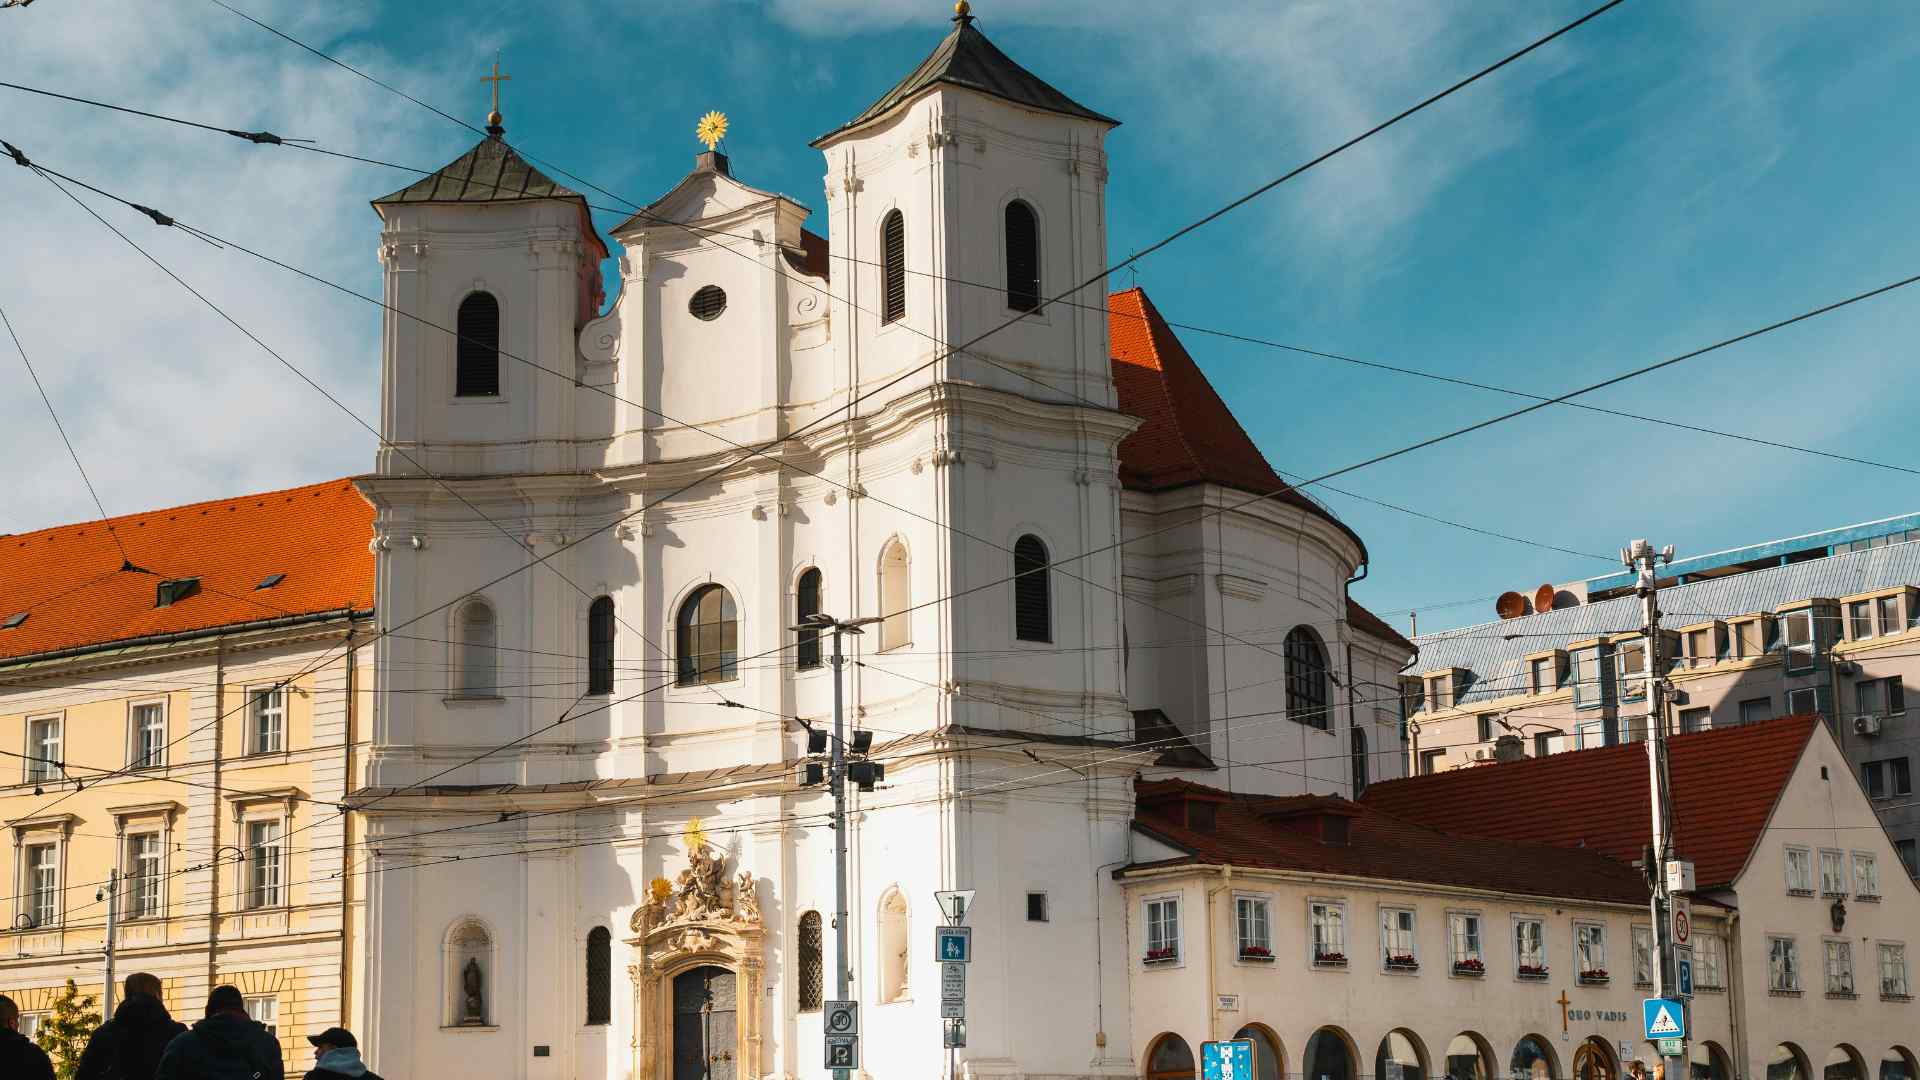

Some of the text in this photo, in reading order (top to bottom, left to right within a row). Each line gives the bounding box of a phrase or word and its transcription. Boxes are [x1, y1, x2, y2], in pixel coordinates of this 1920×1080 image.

[1681, 965, 1689, 988] P
[1568, 1010, 1627, 1022] QUO VADIS
